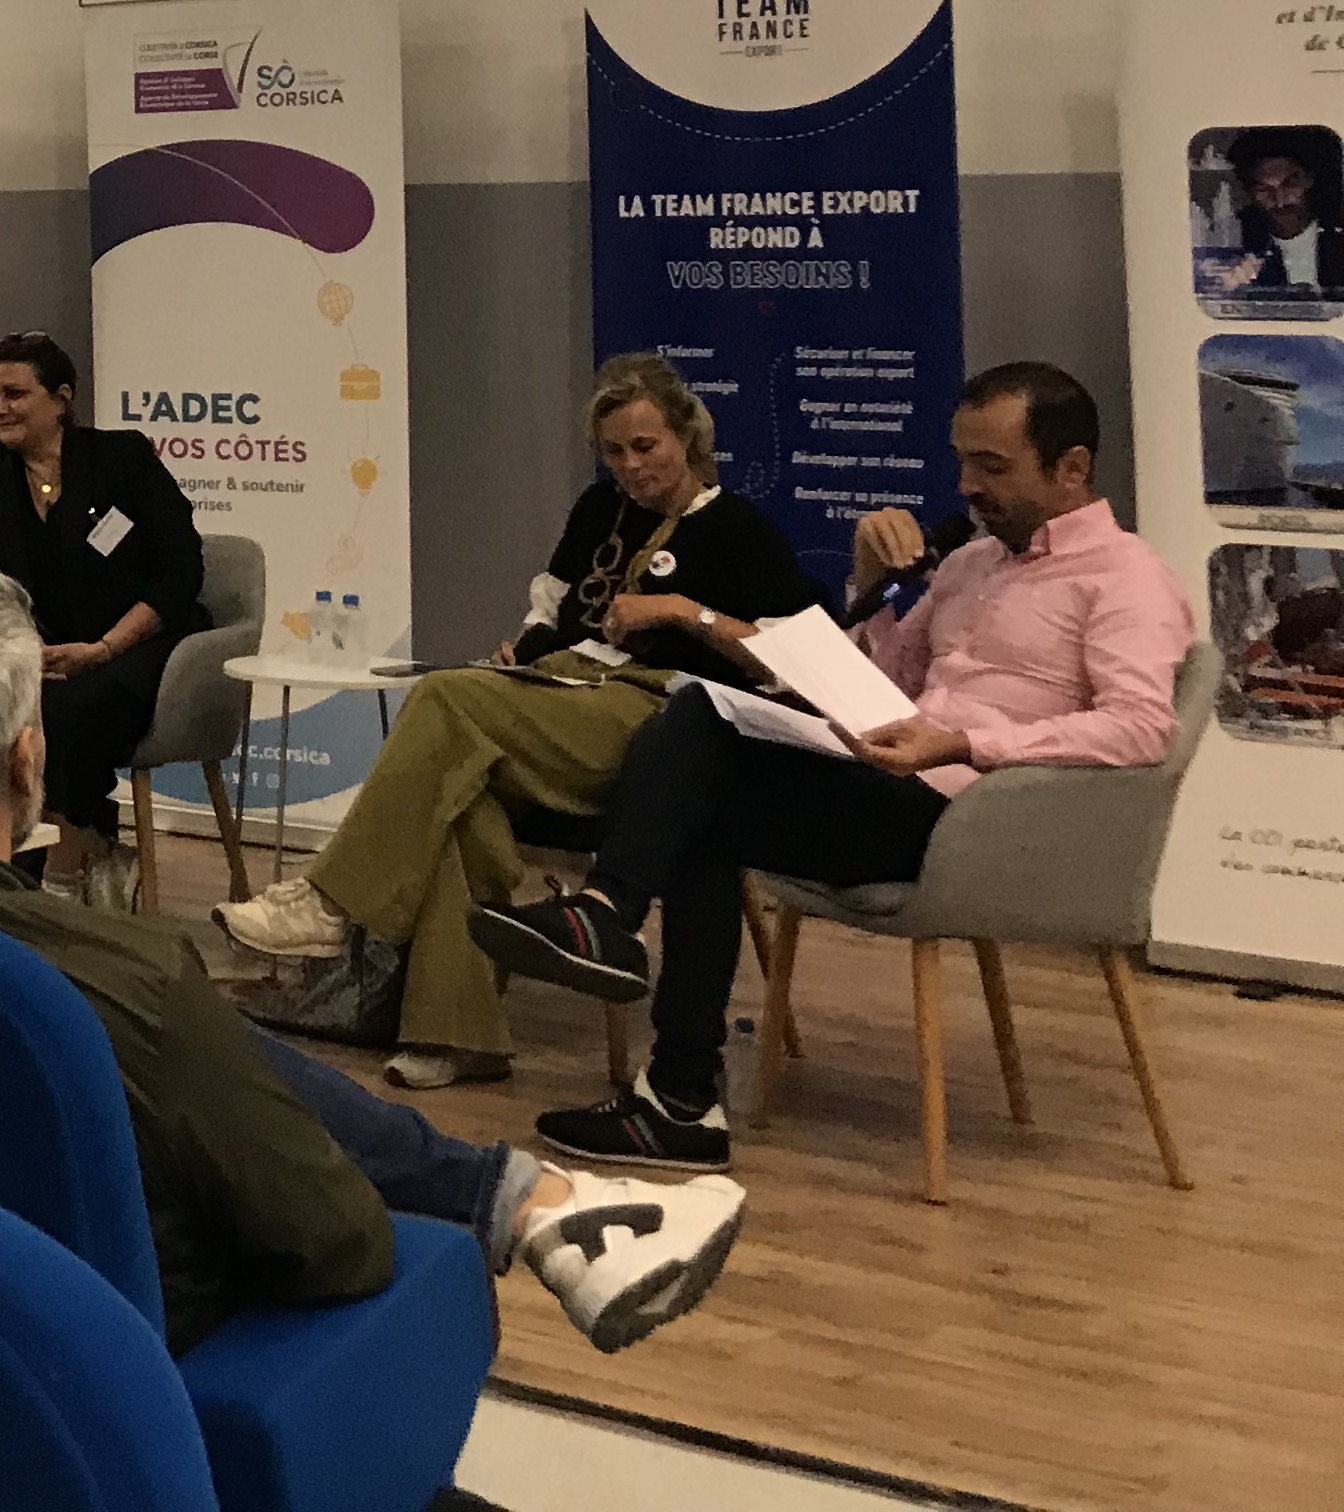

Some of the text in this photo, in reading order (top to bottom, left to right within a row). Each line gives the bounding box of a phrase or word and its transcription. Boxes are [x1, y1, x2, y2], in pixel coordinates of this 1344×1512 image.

[1275, 8, 1296, 24] et
[718, 18, 810, 42] FRANCE
[745, 45, 783, 57] EXPORT
[1305, 33, 1329, 51] de
[256, 88, 344, 108] CORSICA
[618, 189, 920, 218] LA TEAM FRANCE EXPORT
[709, 217, 824, 249] RÉPOND À
[666, 259, 872, 289] VOS BESOINS !
[148, 433, 307, 463] VOS CÔTÉS
[176, 476, 305, 493] agner & soutenir
